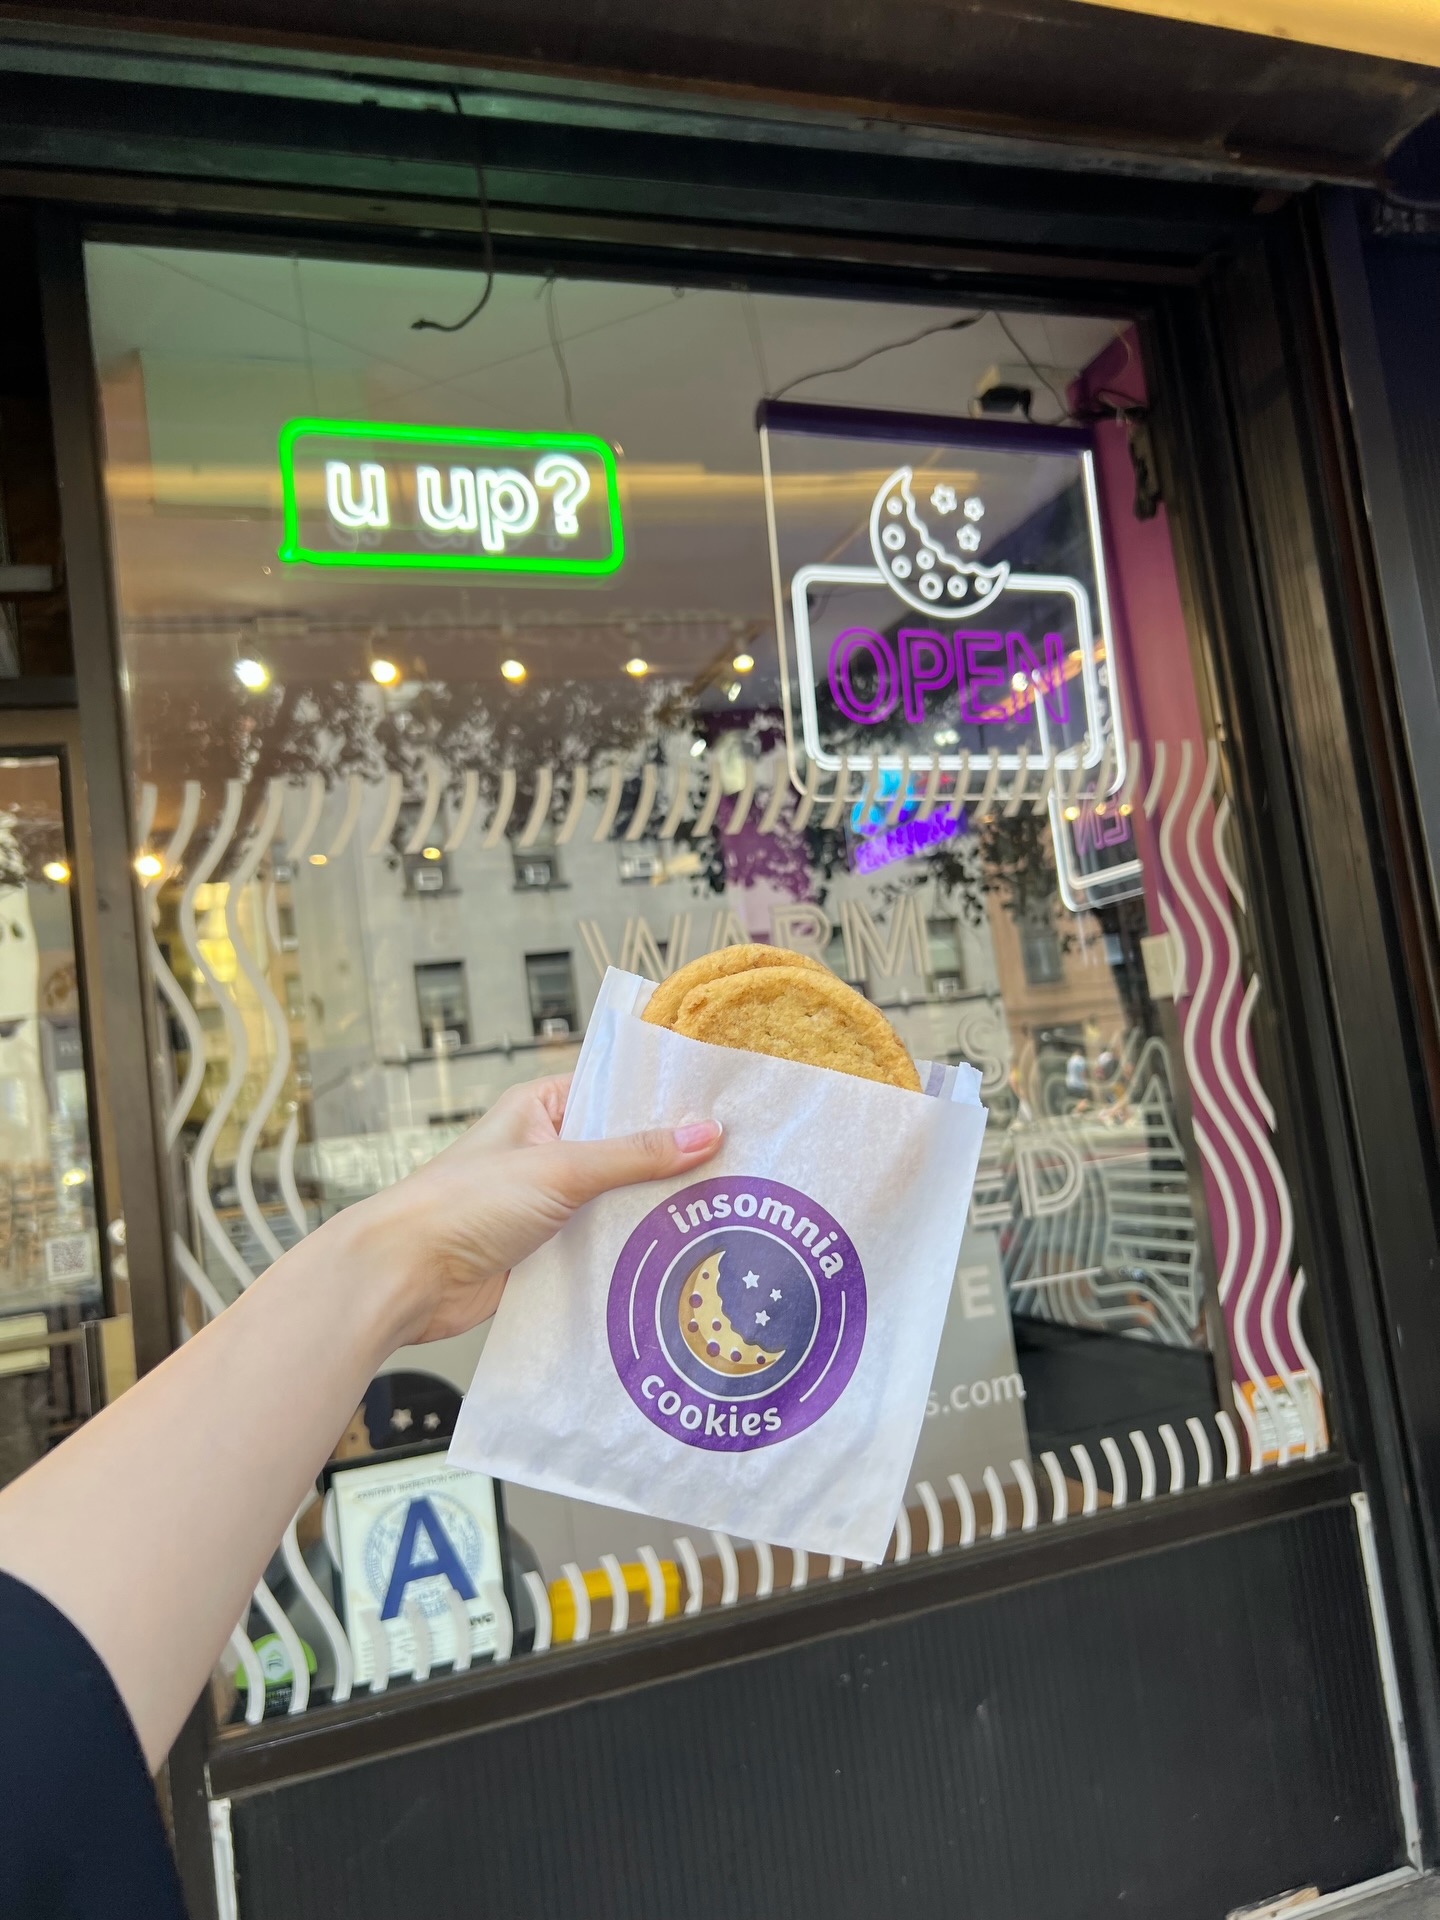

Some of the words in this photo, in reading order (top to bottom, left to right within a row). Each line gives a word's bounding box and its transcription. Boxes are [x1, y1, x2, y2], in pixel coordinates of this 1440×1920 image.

[326, 461, 389, 528] u
[416, 453, 591, 551] up?
[827, 626, 1070, 724] OPEN
[667, 1193, 844, 1279] insomnia
[641, 1374, 782, 1437] cookies
[380, 1495, 479, 1621] A
